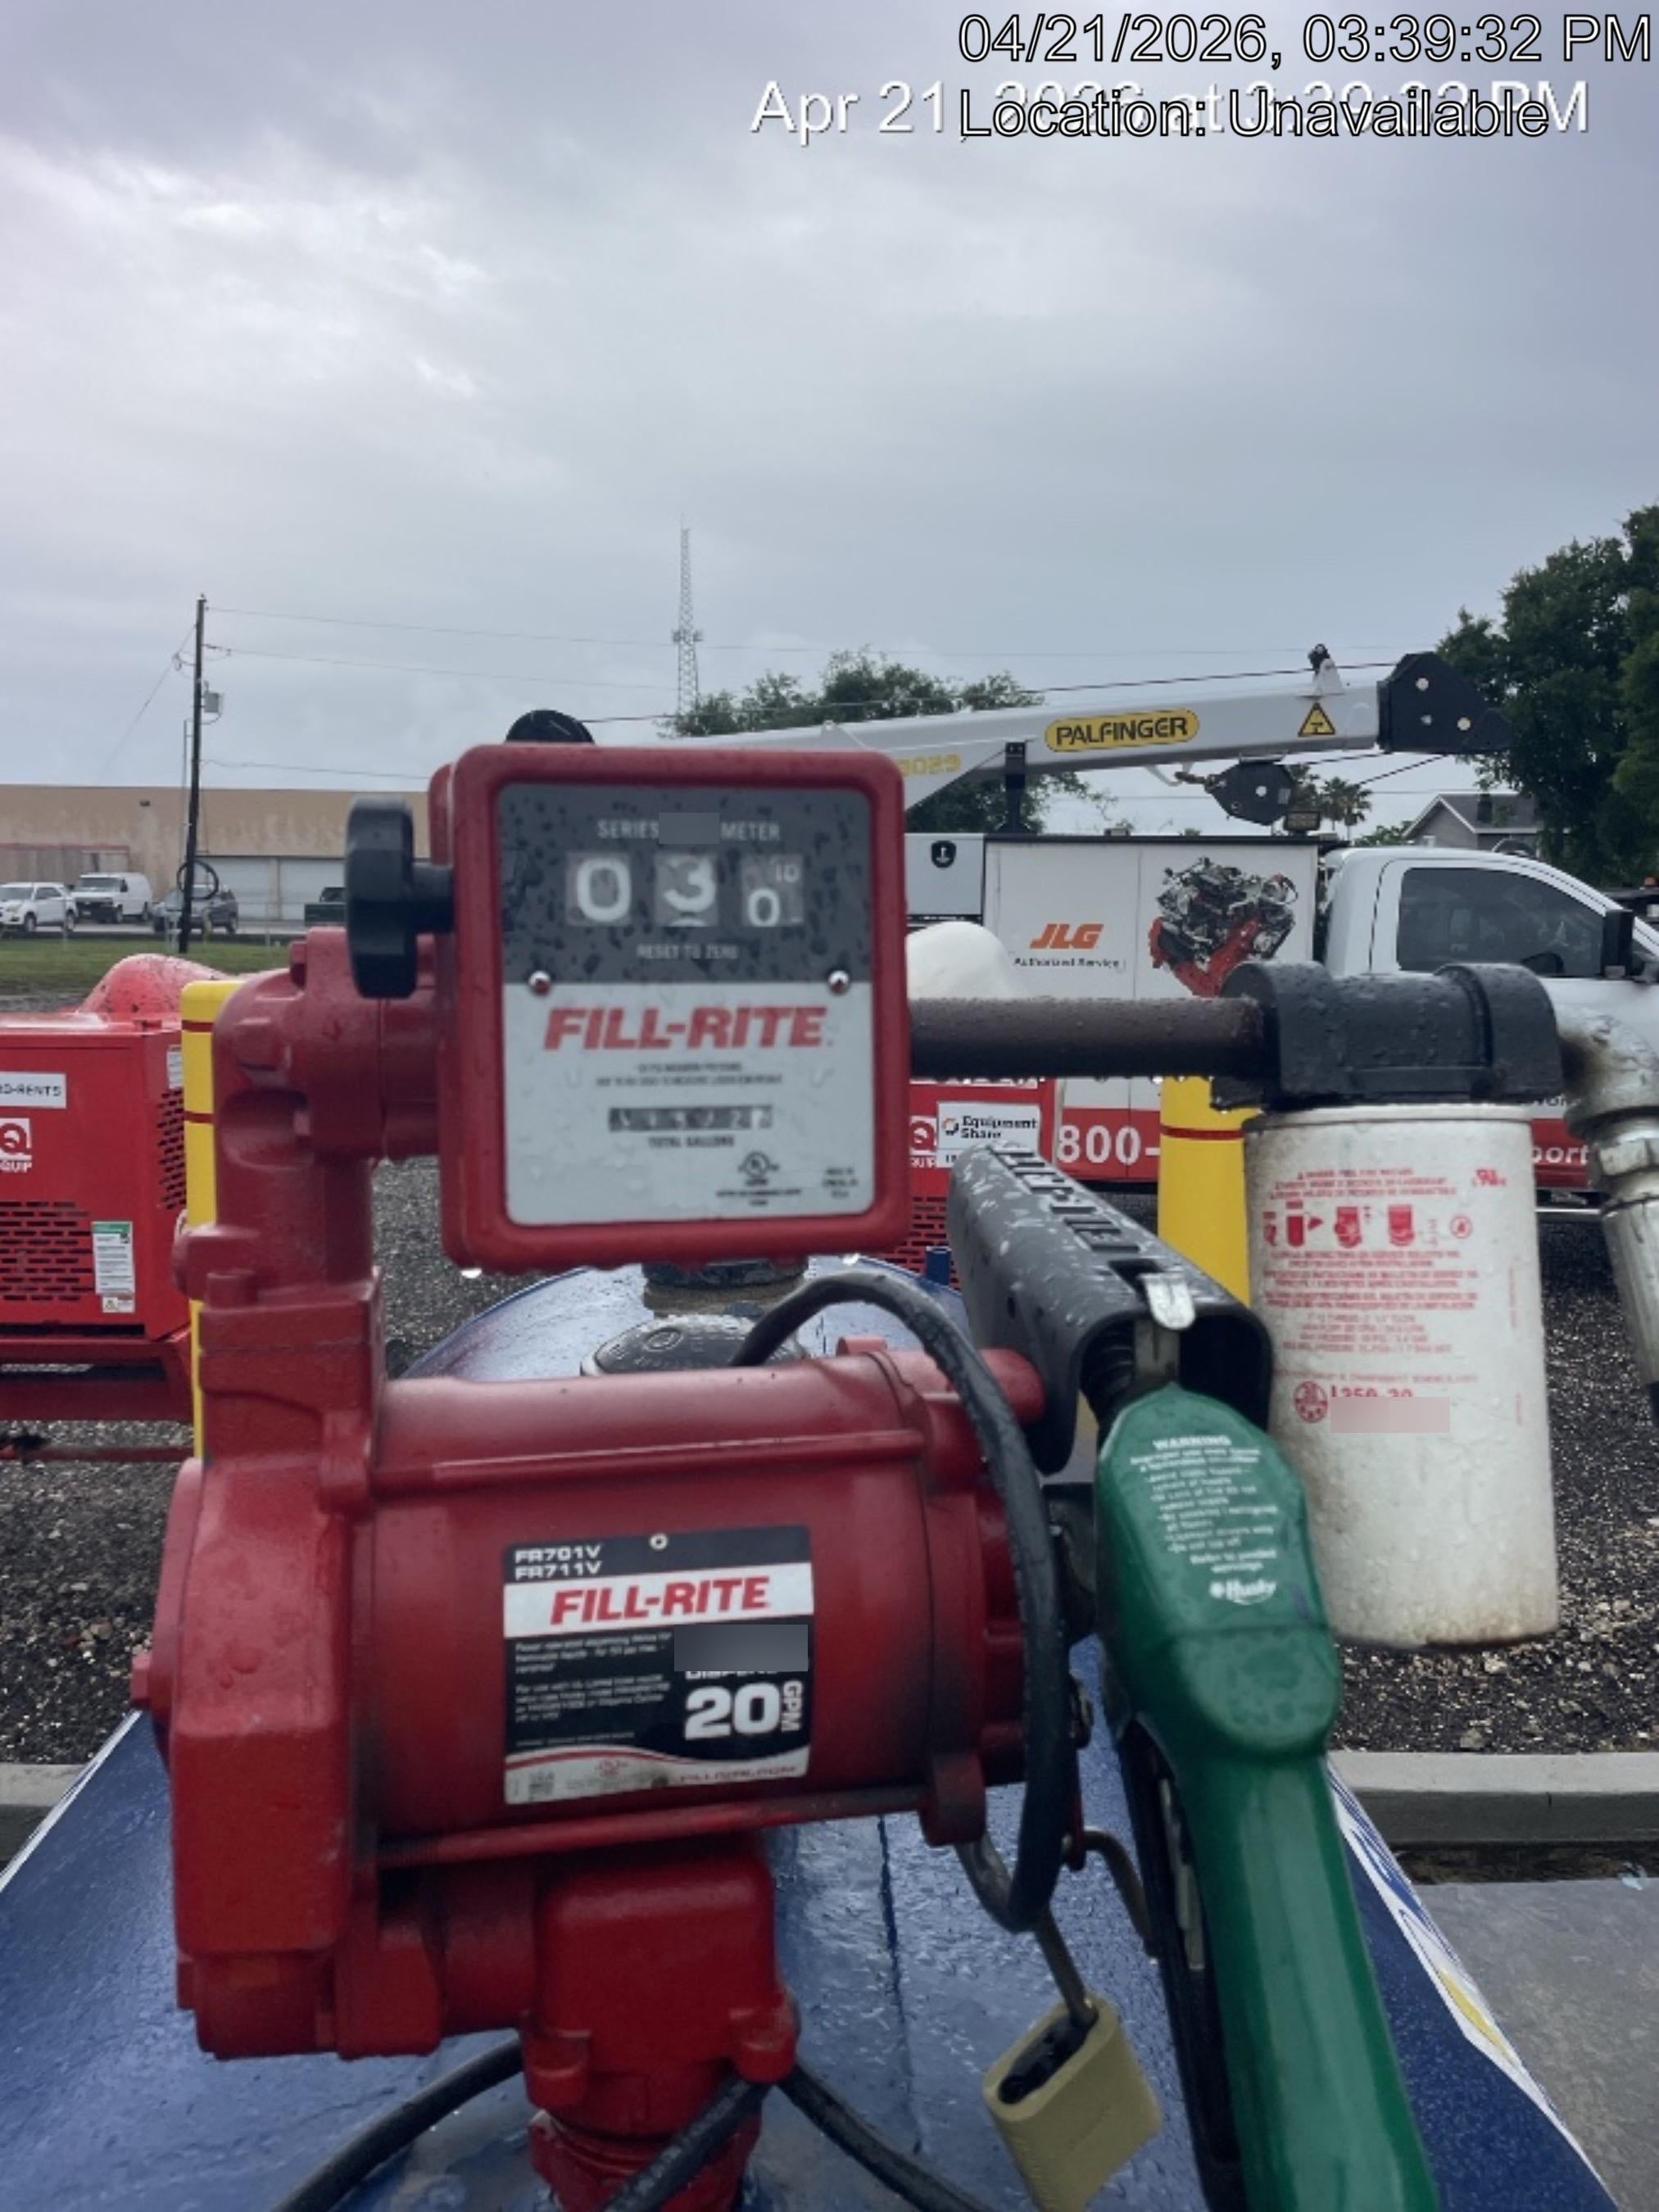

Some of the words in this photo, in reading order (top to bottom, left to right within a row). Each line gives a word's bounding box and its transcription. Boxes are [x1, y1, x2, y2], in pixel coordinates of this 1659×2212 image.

[1055, 714, 1189, 746] PALFINGER
[597, 819, 659, 840] SERIES
[720, 823, 781, 841] METER
[1029, 923, 1104, 950] JLG
[542, 1005, 827, 1050] FILL-RITE
[960, 1127, 1002, 1140] Share
[962, 1114, 1037, 1129] Equipment
[514, 1543, 602, 1564] FR701V
[514, 1561, 603, 1580] FR711V
[550, 1575, 770, 1625] FILL-RITE
[684, 1682, 781, 1741] 20
[781, 1679, 804, 1733] GPM
